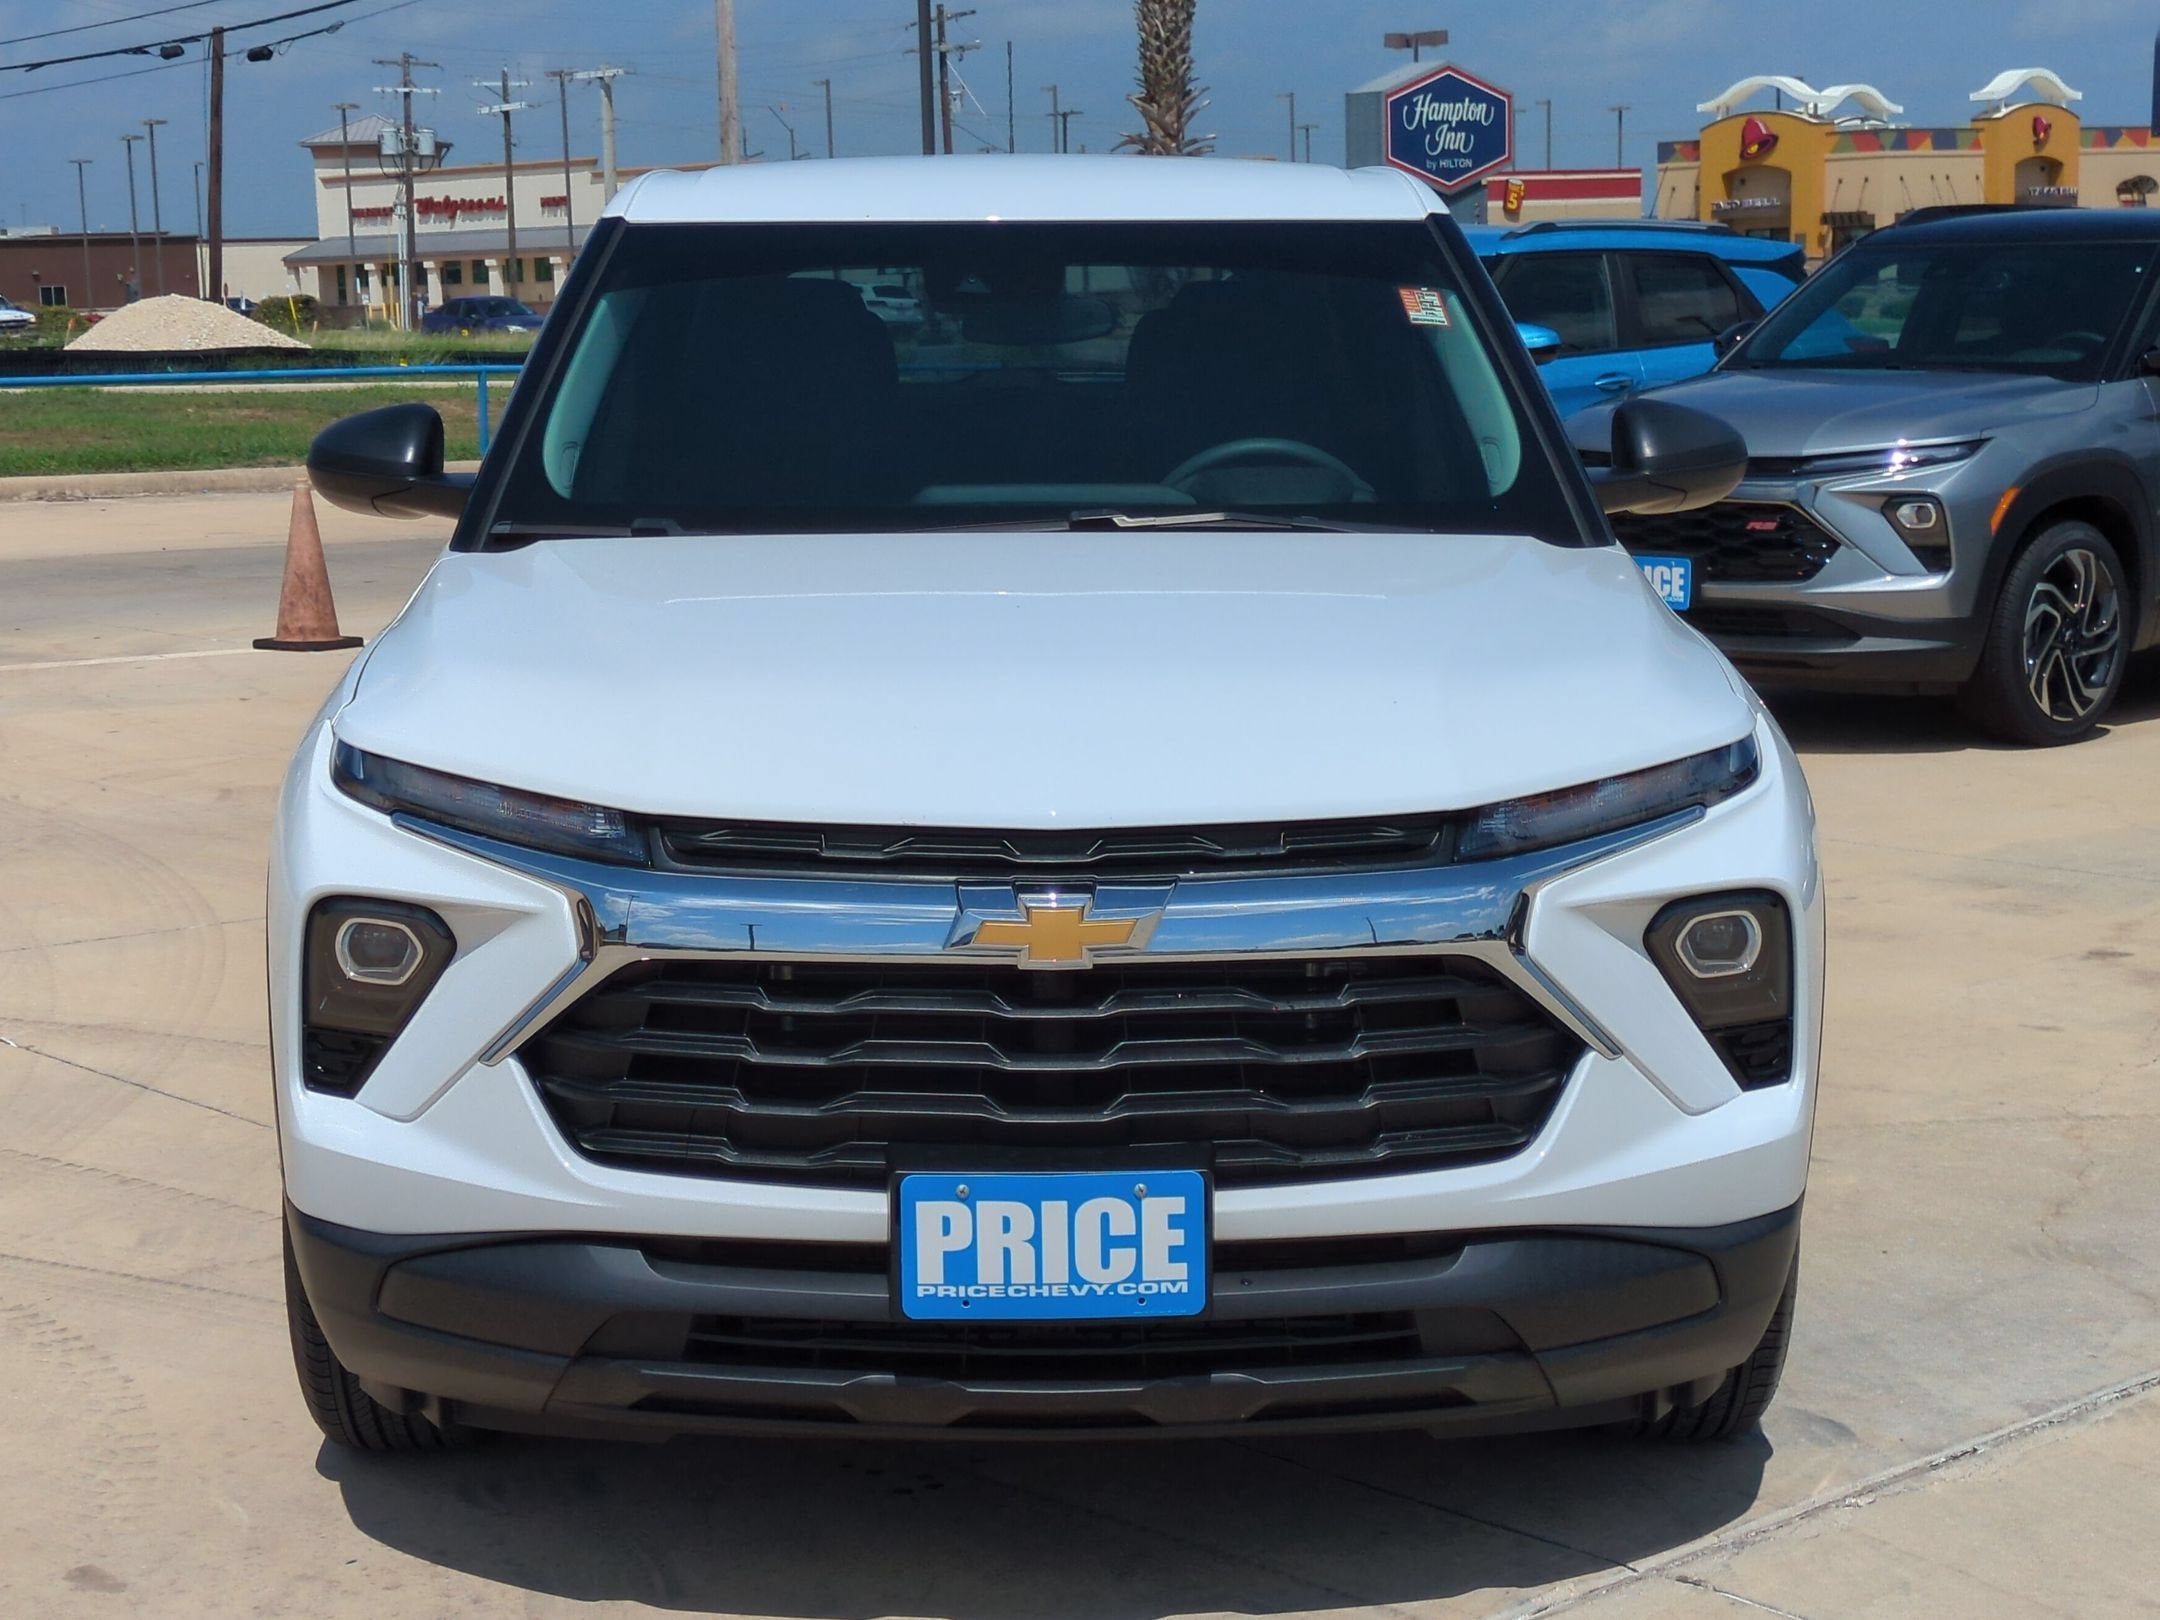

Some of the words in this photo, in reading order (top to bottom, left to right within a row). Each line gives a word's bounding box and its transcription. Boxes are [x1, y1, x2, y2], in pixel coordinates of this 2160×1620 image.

[1403, 93, 1495, 130] Hampton
[1425, 123, 1474, 156] Inn
[1426, 159, 1437, 171] by
[1440, 159, 1473, 168] HILTON
[414, 195, 507, 219] Walgreens
[915, 1197, 1188, 1285] PRICE
[916, 1281, 1189, 1298] PRICECHEVY.COM
